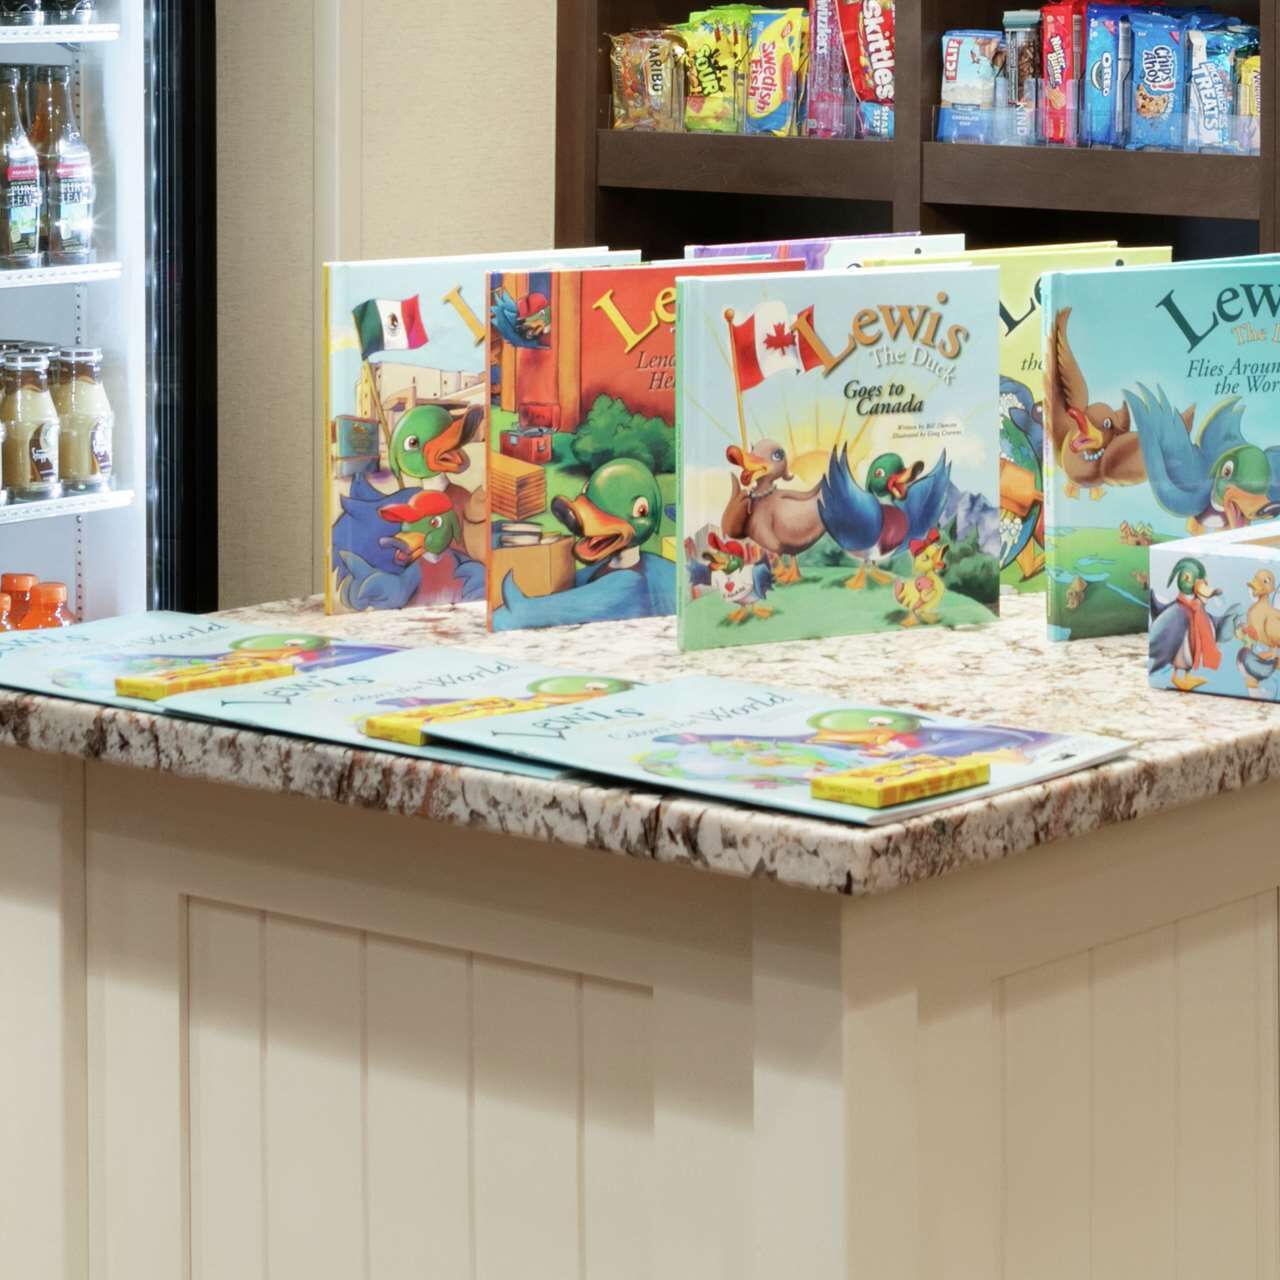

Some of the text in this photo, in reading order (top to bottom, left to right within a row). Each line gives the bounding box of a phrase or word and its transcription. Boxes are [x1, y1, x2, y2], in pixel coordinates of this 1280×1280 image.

[946, 39, 959, 71] CLIF
[1047, 52, 1063, 85] Butter
[1050, 35, 1066, 69] Nutter
[1153, 45, 1171, 85] Chips
[695, 43, 720, 97] SOUR
[748, 58, 763, 98] Fish
[757, 41, 777, 112] Swedish
[1102, 52, 1112, 97] OREO
[1192, 66, 1218, 131] TREATS
[1016, 101, 1027, 136] KIND
[790, 291, 970, 378] Lewis
[1231, 321, 1268, 346] The
[870, 343, 957, 386] The Duck
[1186, 357, 1225, 378] Flies
[843, 379, 905, 400] Goes to
[1214, 375, 1240, 395] the
[856, 393, 924, 416] Canada
[428, 659, 520, 688] World
[709, 691, 794, 722] World
